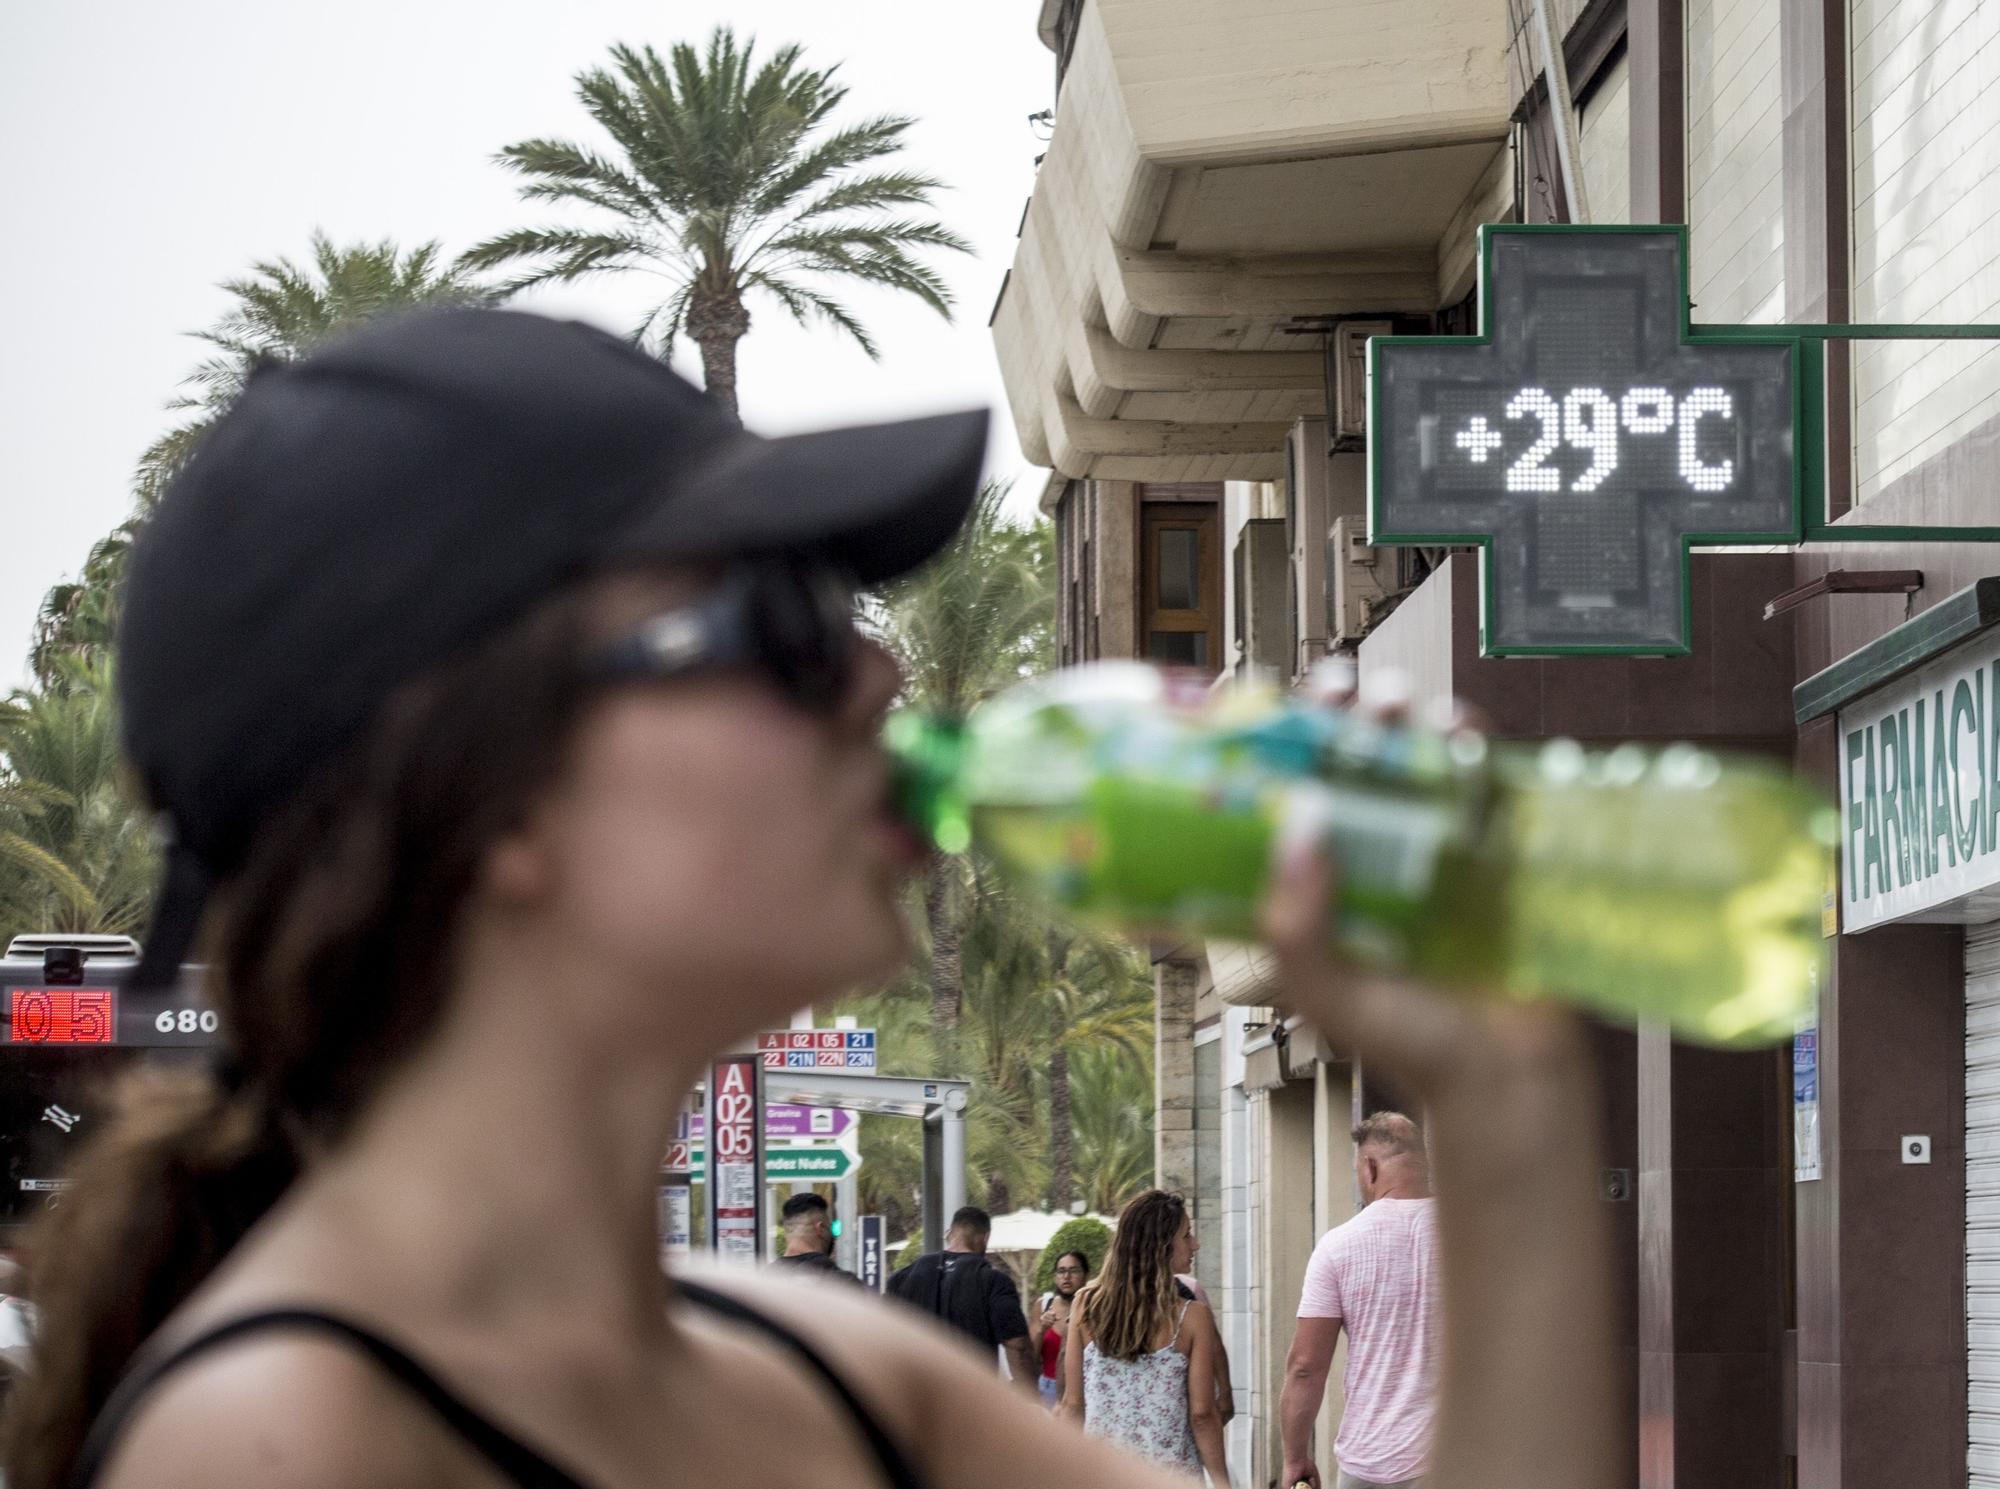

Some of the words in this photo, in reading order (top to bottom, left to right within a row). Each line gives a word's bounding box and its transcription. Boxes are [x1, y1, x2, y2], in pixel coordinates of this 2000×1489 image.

[18, 990, 106, 1041] 05
[155, 1009, 219, 1033] 680
[767, 1034, 777, 1047] A
[793, 1034, 810, 1048] 02
[822, 1034, 839, 1048] 05
[852, 1034, 867, 1047] 21
[764, 1052, 781, 1066] 22
[788, 1052, 814, 1066] 21N
[818, 1052, 844, 1066] 22N
[848, 1052, 873, 1066] 23N
[721, 1063, 745, 1093] A
[716, 1094, 753, 1124] 02
[716, 1125, 753, 1156] 05
[865, 1237, 877, 1287] TAXI
